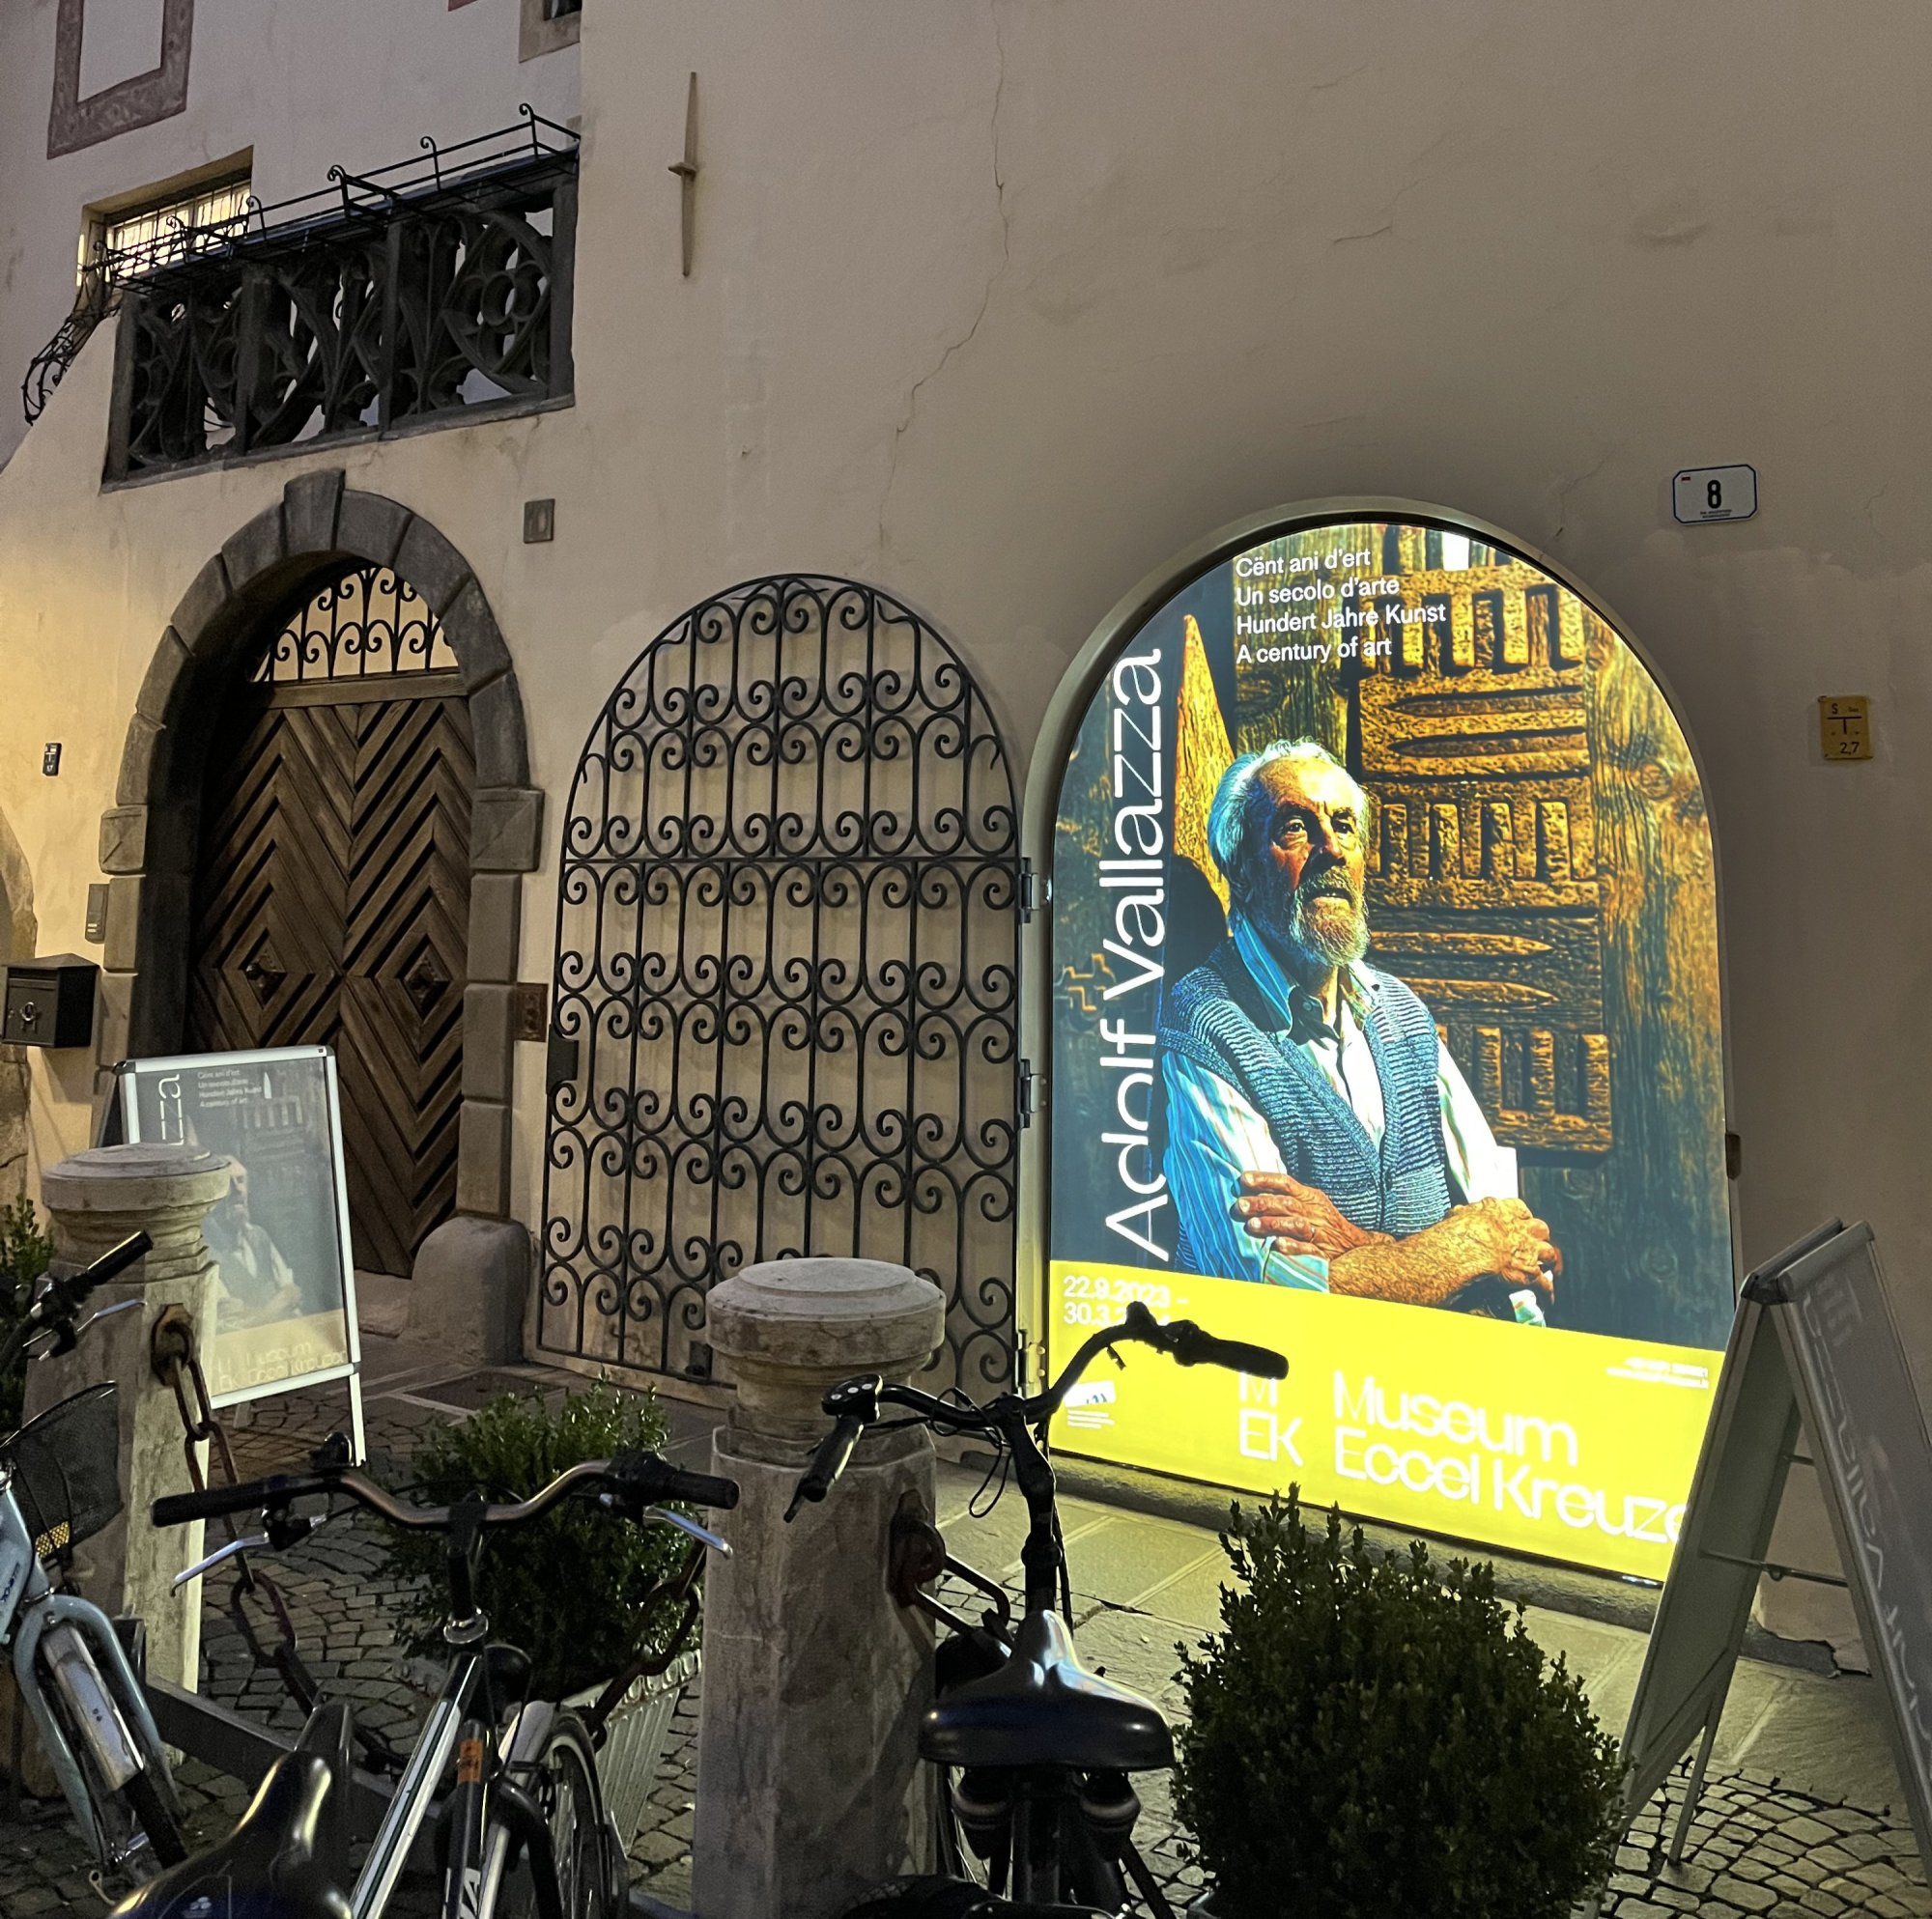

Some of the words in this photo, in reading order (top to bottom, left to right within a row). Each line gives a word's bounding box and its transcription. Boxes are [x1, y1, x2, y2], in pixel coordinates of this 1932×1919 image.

[1707, 479, 1722, 509] 8
[1236, 556, 1284, 578] Cënt
[1289, 550, 1319, 573] ani
[1236, 586, 1264, 607] Un
[1268, 579, 1335, 603] secolo
[1236, 610, 1317, 635] Hundert
[1321, 607, 1379, 630] Jahre
[1385, 604, 1447, 625] Kunst
[1236, 644, 1252, 664] A
[1256, 640, 1332, 663] century
[1337, 635, 1359, 658] of
[1363, 637, 1392, 657] art
[1098, 648, 1166, 1002] Vallazza
[1099, 1018, 1169, 1263] Adolf
[1239, 1407, 1304, 1467] EK
[1333, 1369, 1578, 1468] Museum
[1334, 1425, 1481, 1505] Eccel
